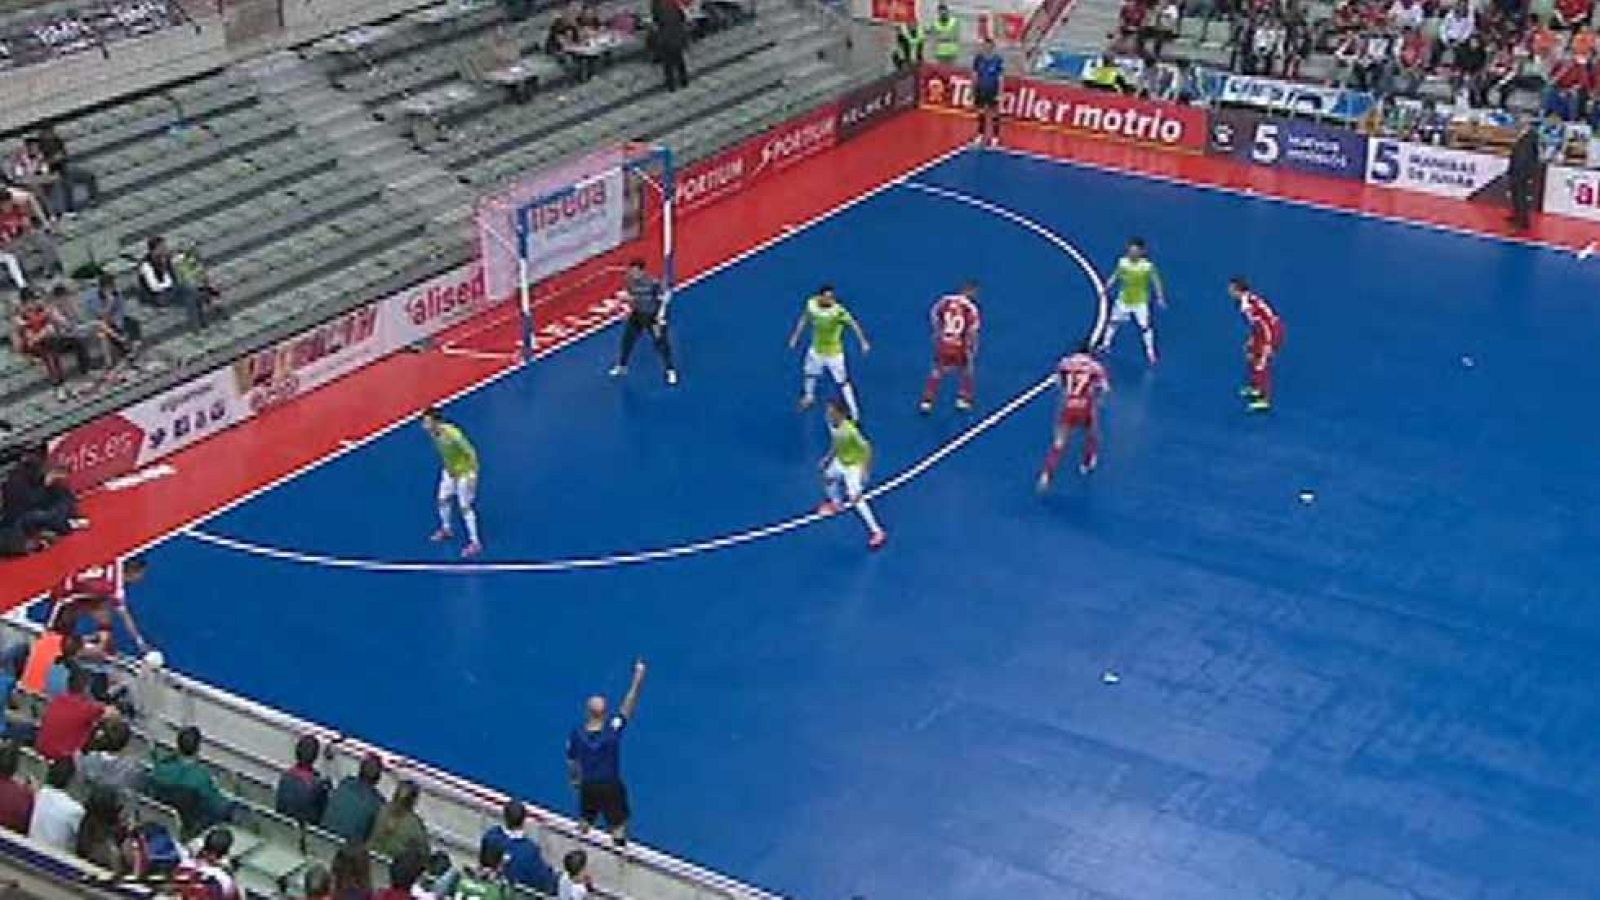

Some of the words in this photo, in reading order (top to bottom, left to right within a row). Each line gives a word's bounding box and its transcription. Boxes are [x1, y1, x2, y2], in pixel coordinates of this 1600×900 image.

[999, 87, 1071, 122] aller
[1073, 104, 1182, 140] motrio
[1253, 124, 1279, 163] 5
[1371, 142, 1400, 182] 5
[675, 156, 743, 205] PORTIUM
[411, 264, 485, 326] alised
[1067, 373, 1089, 395] 17
